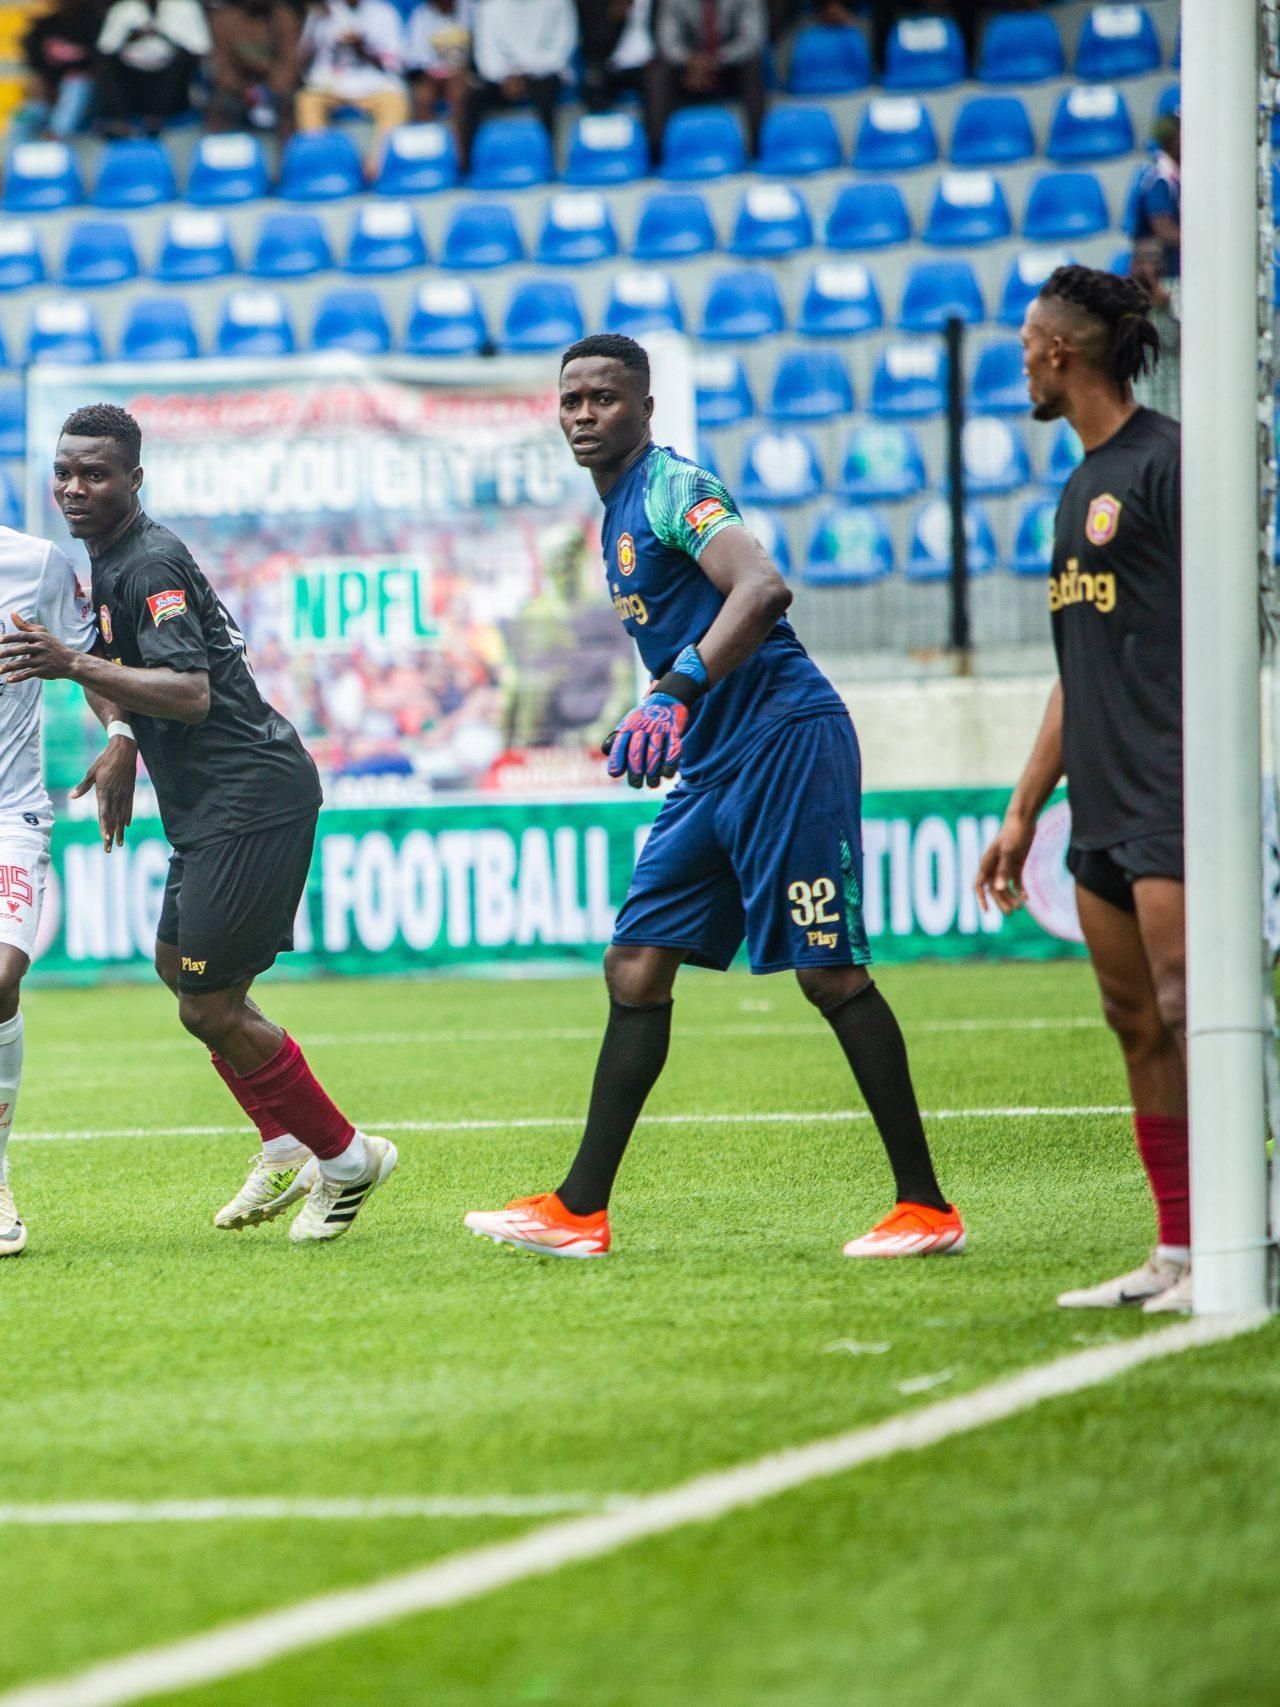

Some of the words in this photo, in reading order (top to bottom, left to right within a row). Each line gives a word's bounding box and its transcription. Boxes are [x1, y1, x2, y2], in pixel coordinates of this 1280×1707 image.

[293, 567, 440, 640] NPFL
[321, 826, 618, 953] FOOTBALL
[787, 877, 839, 927] 32
[806, 930, 839, 949] Play
[181, 955, 207, 975] Play
